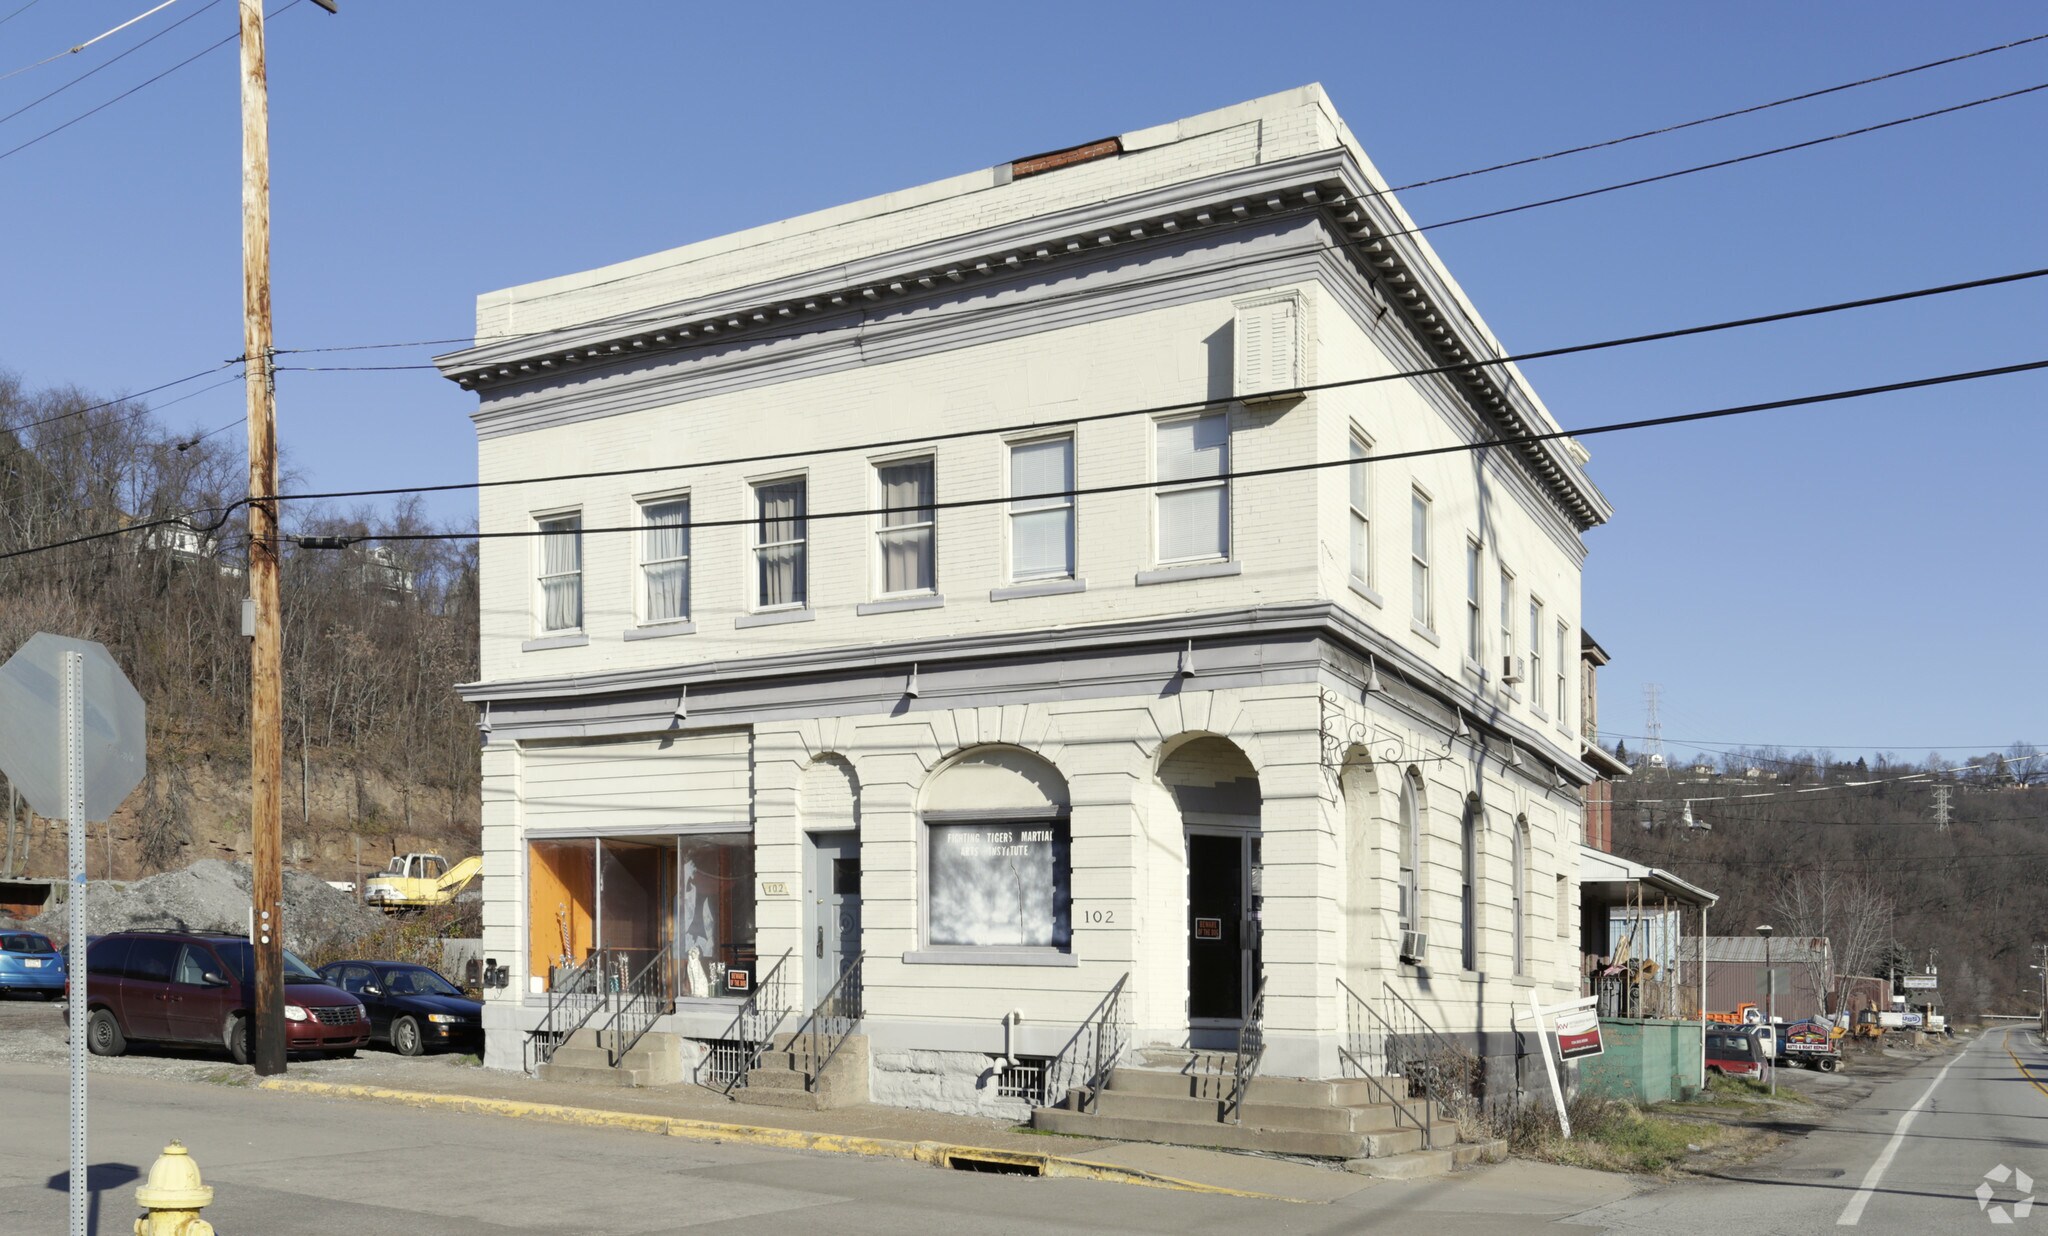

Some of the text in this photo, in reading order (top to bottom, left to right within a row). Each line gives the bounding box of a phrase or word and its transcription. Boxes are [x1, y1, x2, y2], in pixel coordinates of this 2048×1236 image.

[947, 831, 1053, 844] FIGHTING TIGERS MARTIAL
[961, 845, 1028, 857] ARTS INSTITUTE
[768, 884, 783, 893] 102
[1084, 911, 1114, 924] 102
